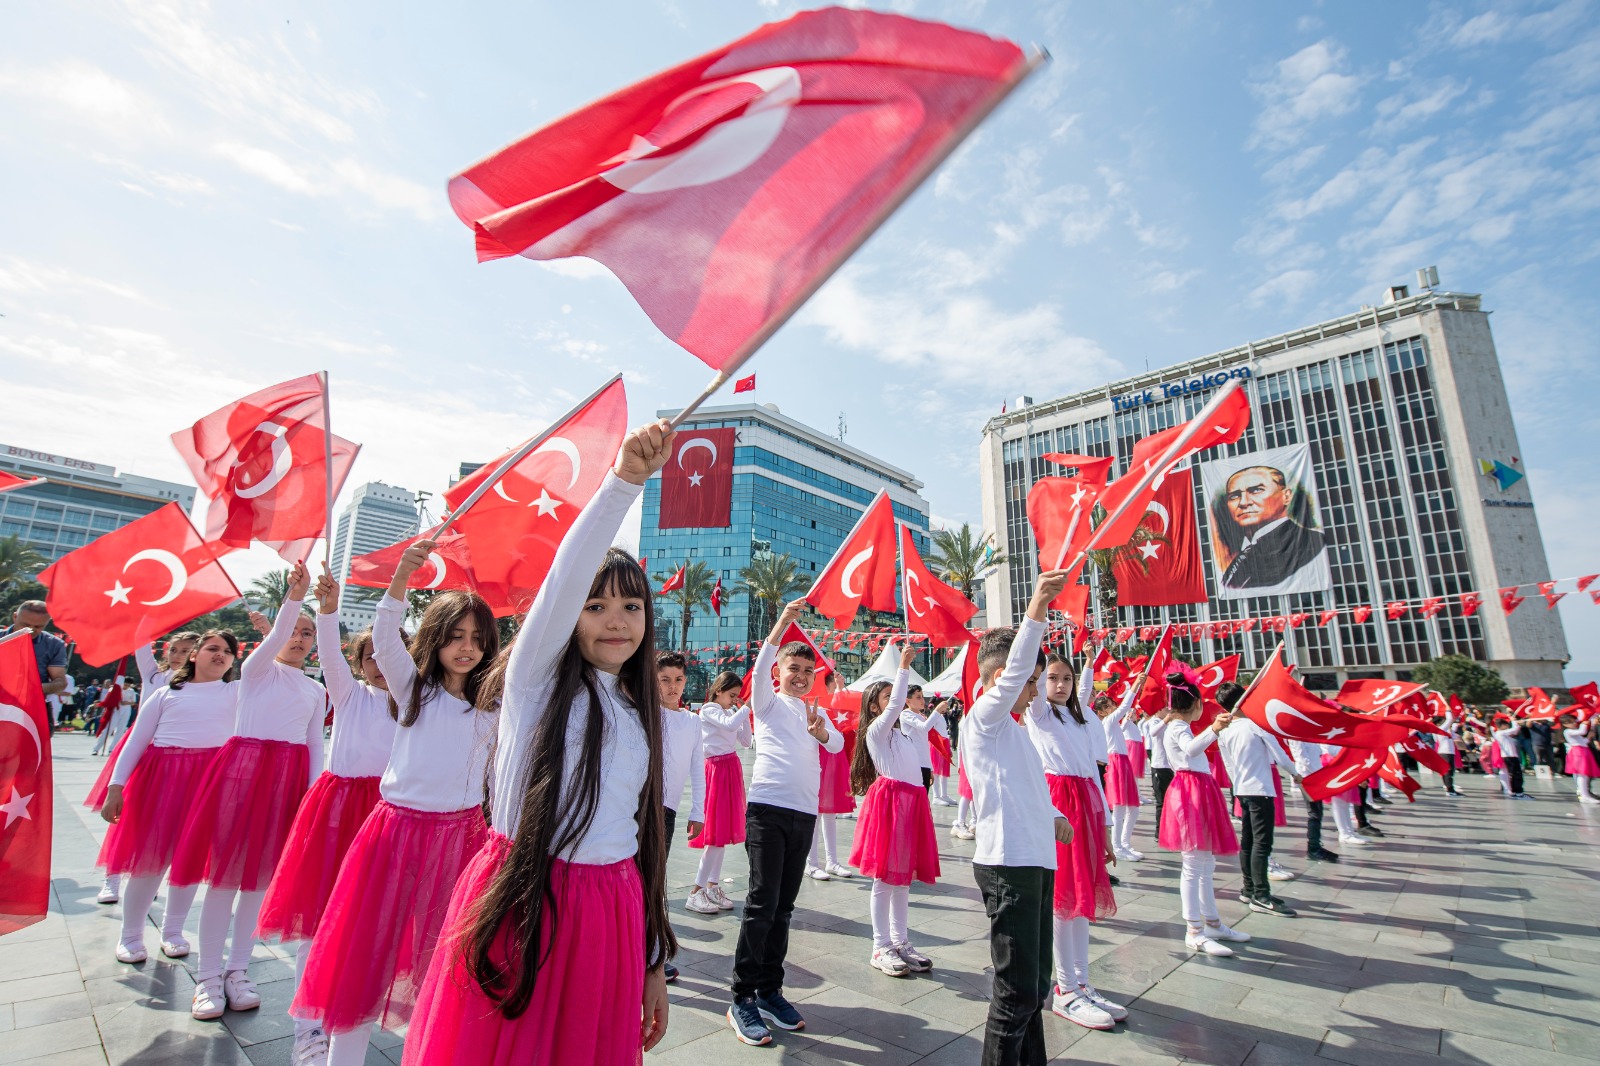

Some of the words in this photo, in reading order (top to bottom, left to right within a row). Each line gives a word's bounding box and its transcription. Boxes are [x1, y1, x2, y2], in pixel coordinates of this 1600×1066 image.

[1111, 389, 1152, 411] Türk
[1160, 366, 1251, 399] Telekom
[64, 457, 96, 470] EFES
